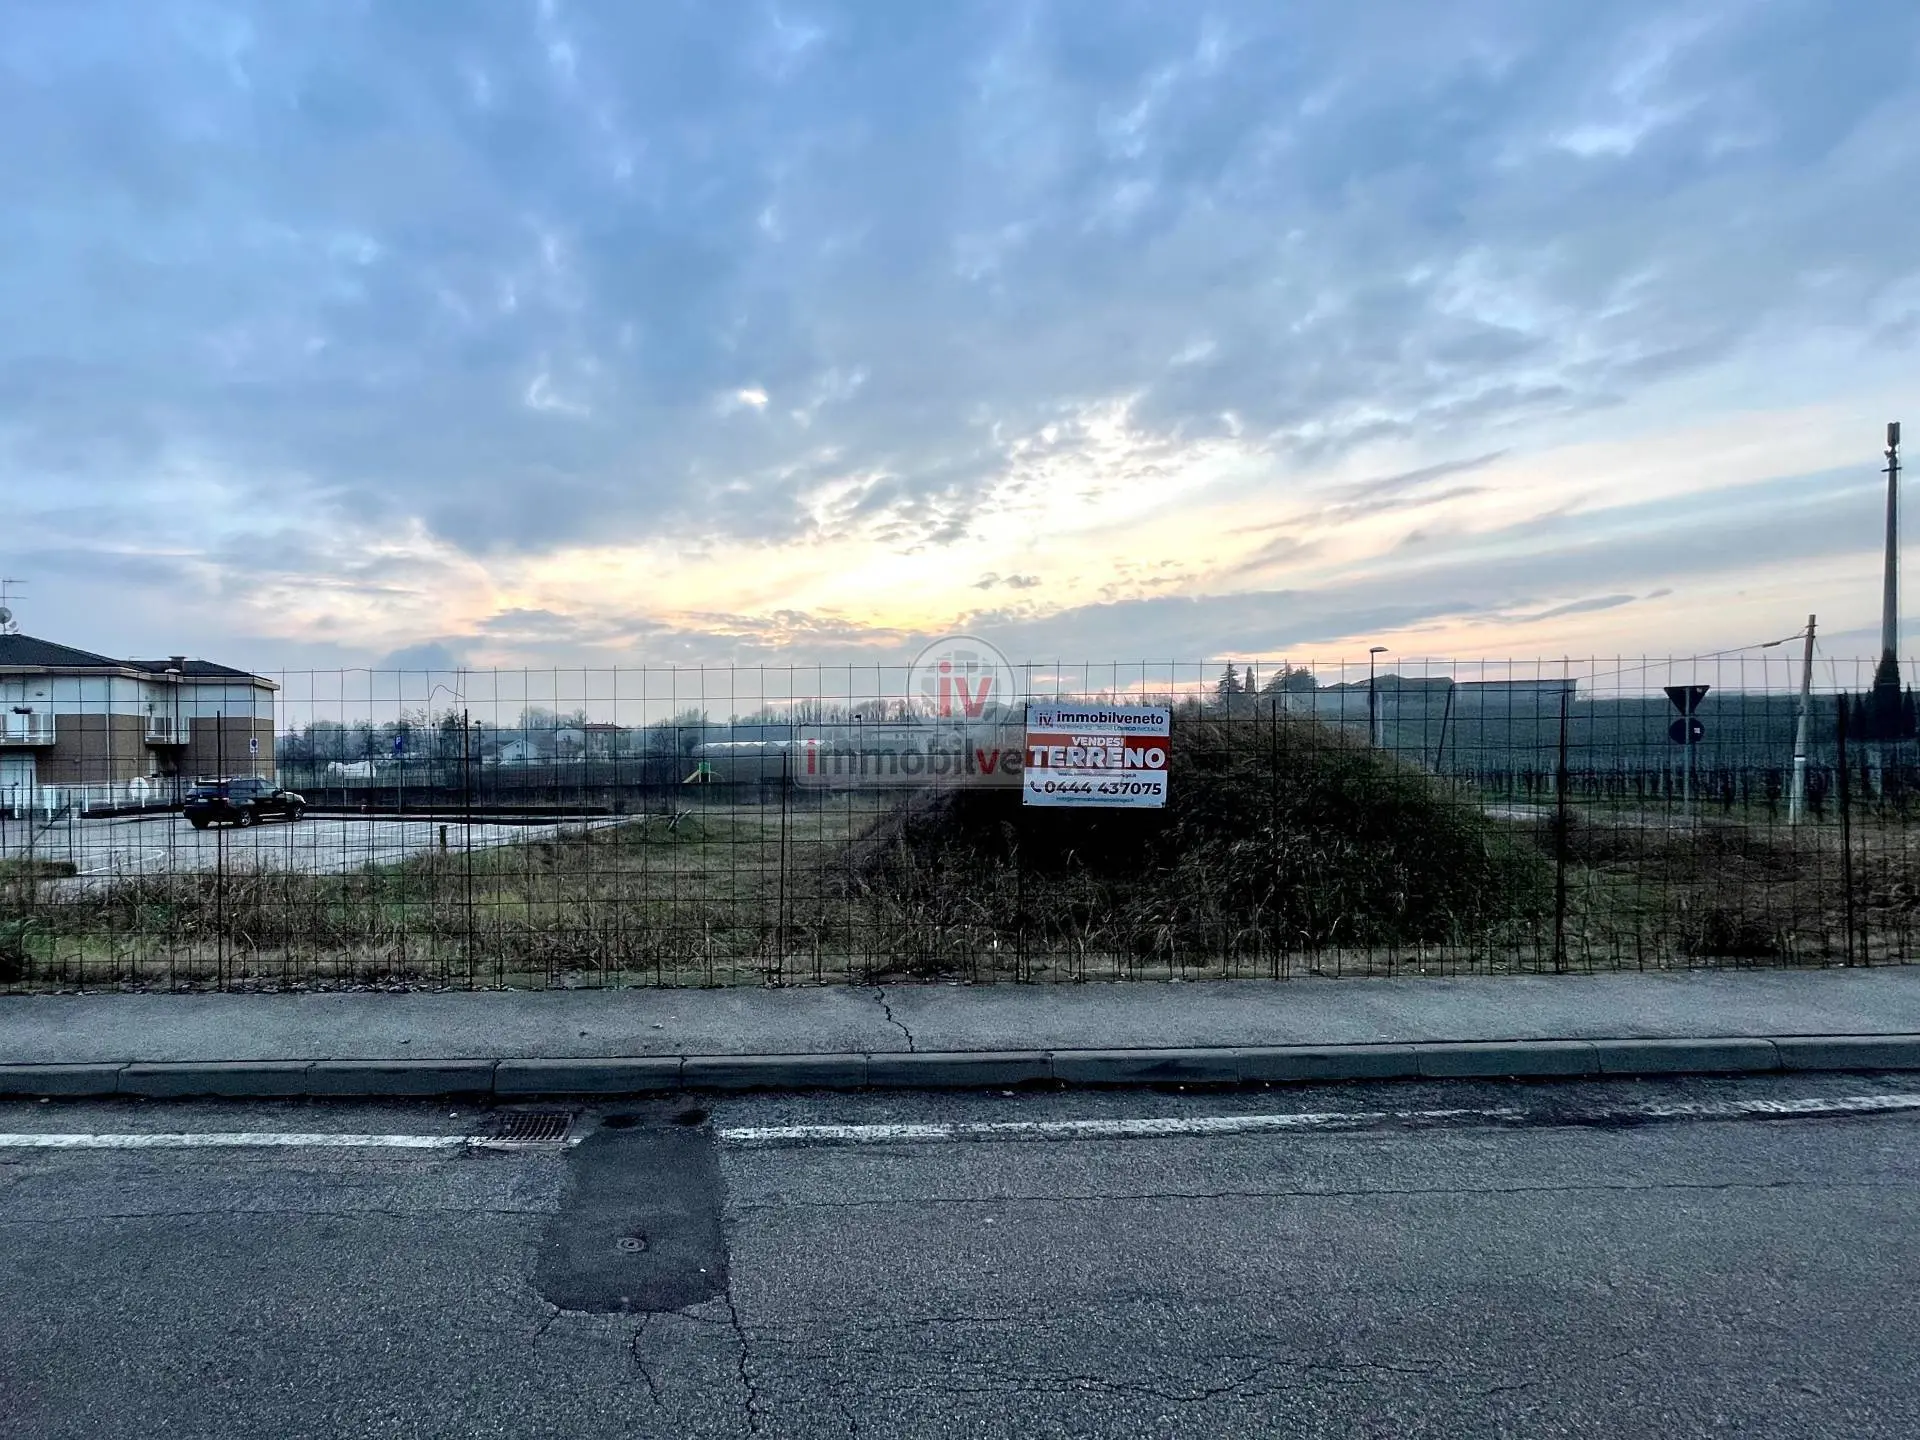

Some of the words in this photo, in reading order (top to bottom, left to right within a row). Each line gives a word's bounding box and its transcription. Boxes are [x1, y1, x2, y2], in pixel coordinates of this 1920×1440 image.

[1056, 710, 1164, 725] immobilveneto
[1071, 736, 1125, 747] VENDESI
[1029, 745, 1166, 769] TERRENO
[1044, 780, 1092, 794] 0444
[1098, 782, 1162, 795] 437075
